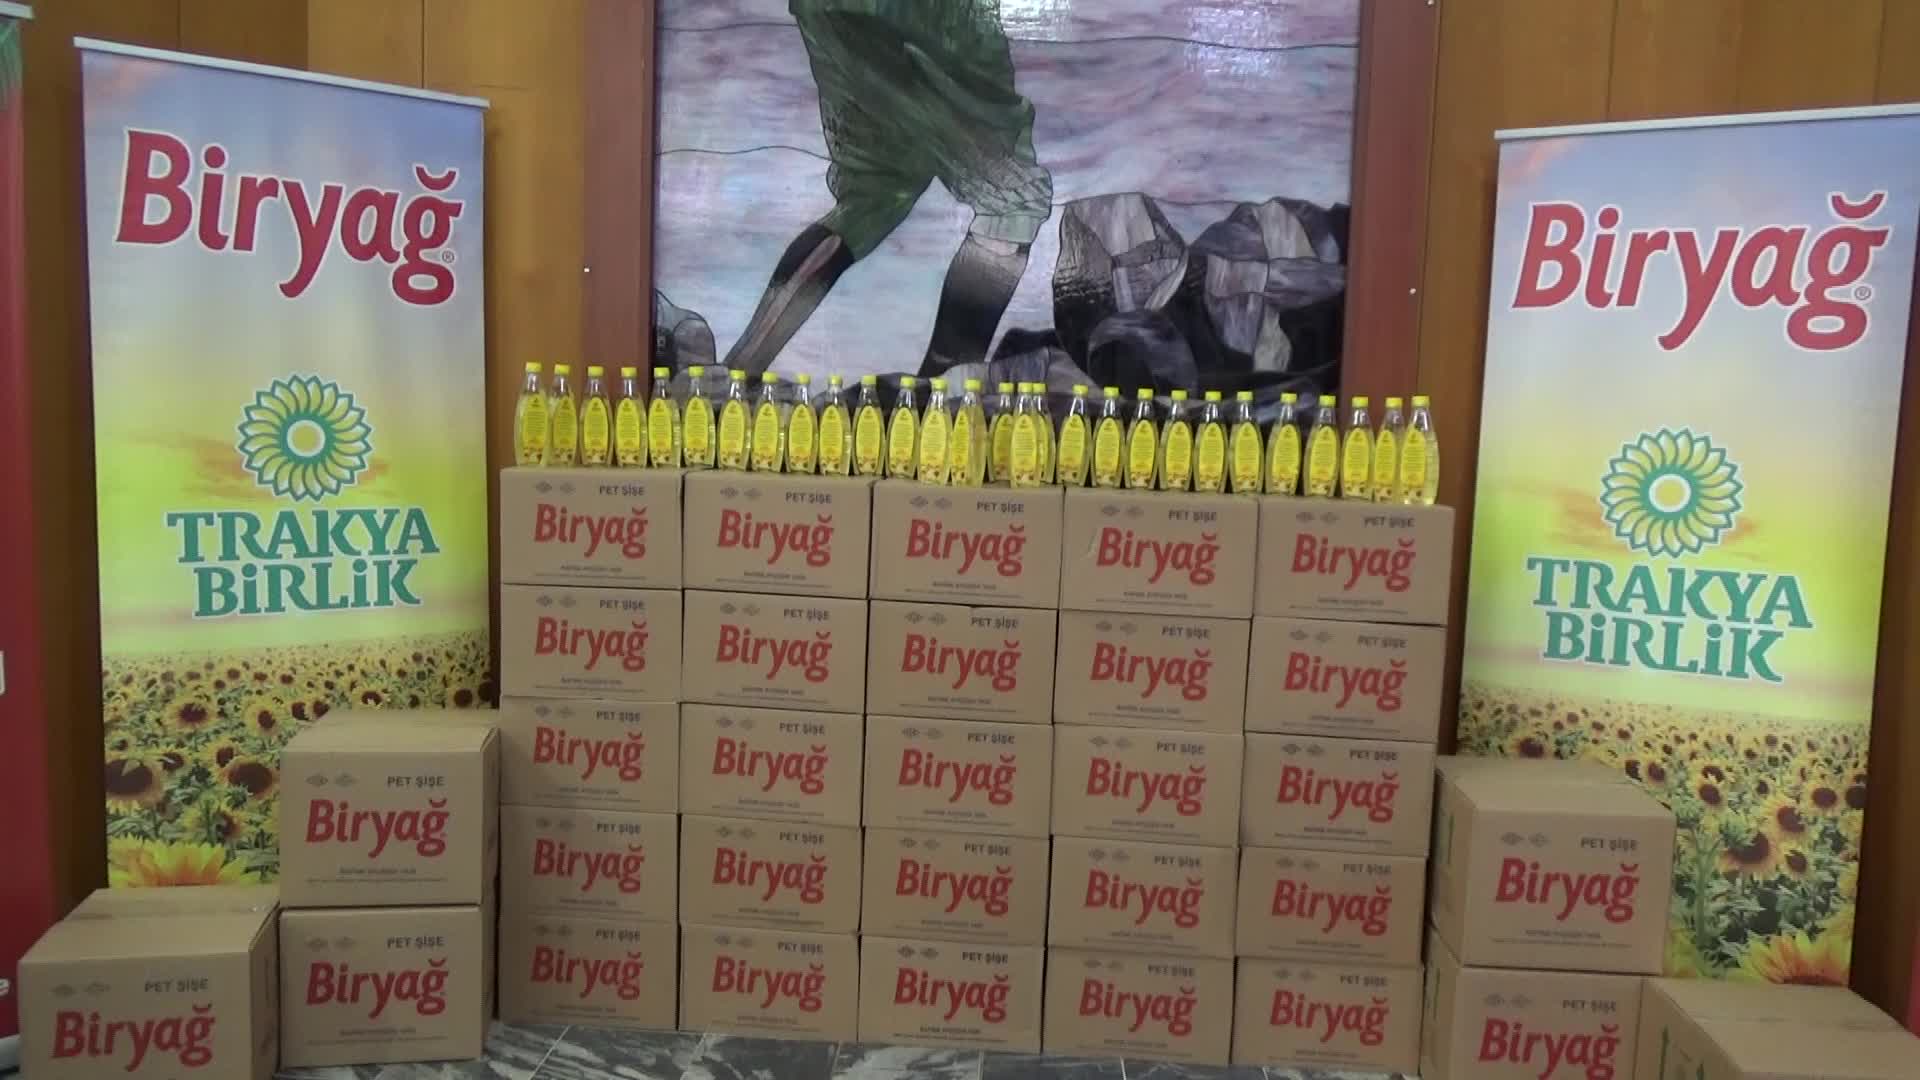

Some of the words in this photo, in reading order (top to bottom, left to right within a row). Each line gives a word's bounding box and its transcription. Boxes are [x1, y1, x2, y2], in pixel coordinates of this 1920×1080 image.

[116, 129, 463, 305] Biryağ
[1512, 190, 1890, 352] Biryağ
[600, 485, 619, 495] PET
[786, 492, 806, 502] PET
[977, 501, 997, 512] PET
[1168, 510, 1189, 520] PET
[167, 507, 440, 562] TRAKYA
[533, 504, 649, 560] Biryağ
[719, 509, 832, 568] Biryağ
[906, 518, 1025, 576] Biryağ
[1096, 526, 1217, 586] Biryağ
[1291, 532, 1416, 592] Biryağ
[600, 600, 619, 609] PET
[784, 609, 803, 619] PET
[1526, 556, 1814, 629] TRAKYA
[535, 616, 650, 672] Biryağ
[971, 617, 992, 627] PET
[1162, 626, 1183, 636] PET
[718, 624, 832, 684] Biryağ
[902, 632, 1022, 694] Biryağ
[1090, 639, 1211, 701] Biryağ
[1283, 649, 1407, 714] Biryağ
[596, 711, 615, 721] PET
[780, 723, 799, 733] PET
[968, 733, 988, 743] PET
[387, 776, 411, 787] PET
[531, 726, 644, 783] Biryağ
[712, 737, 830, 796] Biryağ
[899, 745, 1016, 806] Biryağ
[1087, 756, 1205, 816] Biryağ
[1278, 765, 1400, 824] Biryağ
[305, 797, 449, 858] Biryağ
[597, 822, 616, 832] PET
[780, 832, 798, 841] PET
[1581, 838, 1604, 848] PET
[533, 838, 644, 895] Biryağ
[713, 848, 825, 904] Biryağ
[895, 855, 1012, 917] Biryağ
[1496, 855, 1638, 925] Biryağ
[1086, 867, 1201, 928] Biryağ
[1271, 878, 1391, 938] Biryağ
[387, 937, 411, 948] PET
[777, 941, 797, 952] PET
[962, 952, 982, 962] PET
[145, 981, 173, 992] PET
[305, 957, 448, 1018] Biryağ
[530, 944, 643, 1000] Biryağ
[711, 955, 826, 1012] Biryağ
[895, 965, 1008, 1024] Biryağ
[53, 1003, 216, 1072] Biryağ
[1078, 979, 1197, 1039] Biryağ
[1270, 990, 1387, 1046] Biryağ
